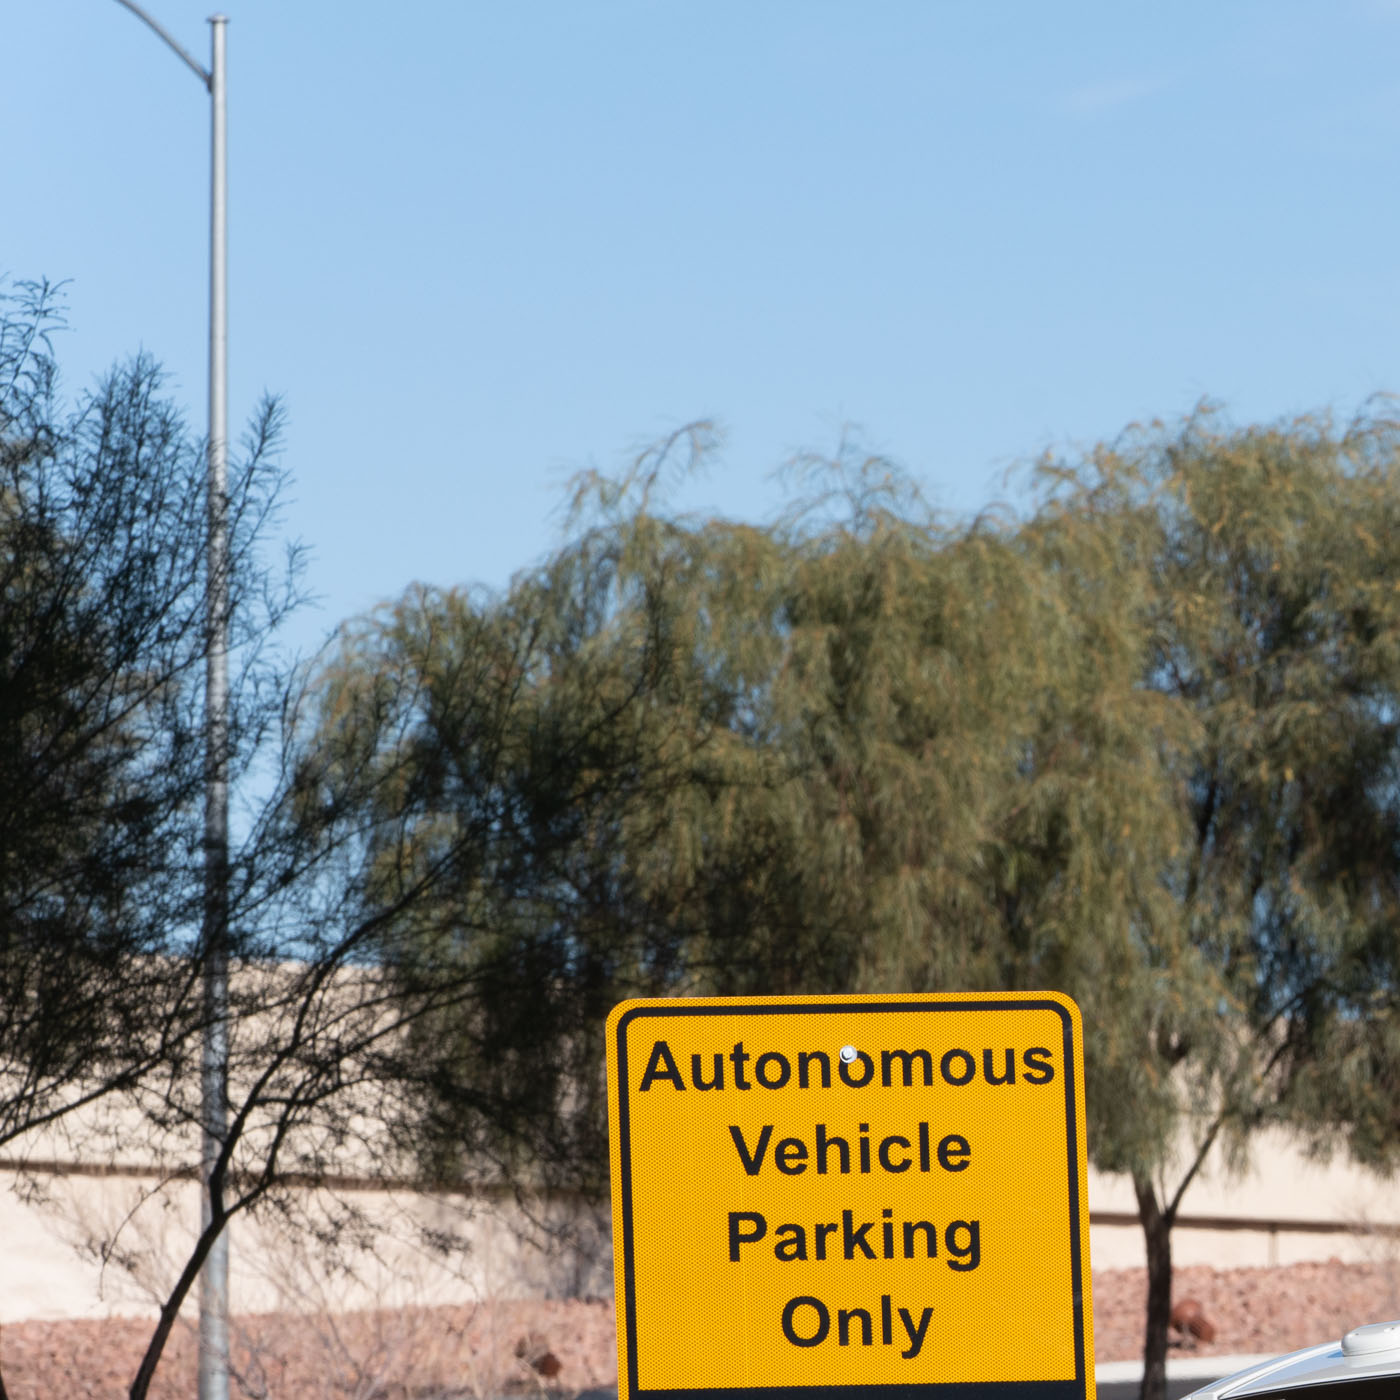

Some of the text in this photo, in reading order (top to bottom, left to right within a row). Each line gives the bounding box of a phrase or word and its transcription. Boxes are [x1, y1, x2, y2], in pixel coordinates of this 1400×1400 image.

[639, 1041, 1055, 1092] Autonomous
[728, 1122, 972, 1176] Vehicle
[728, 1209, 981, 1272] Parking
[781, 1294, 934, 1360] Only
